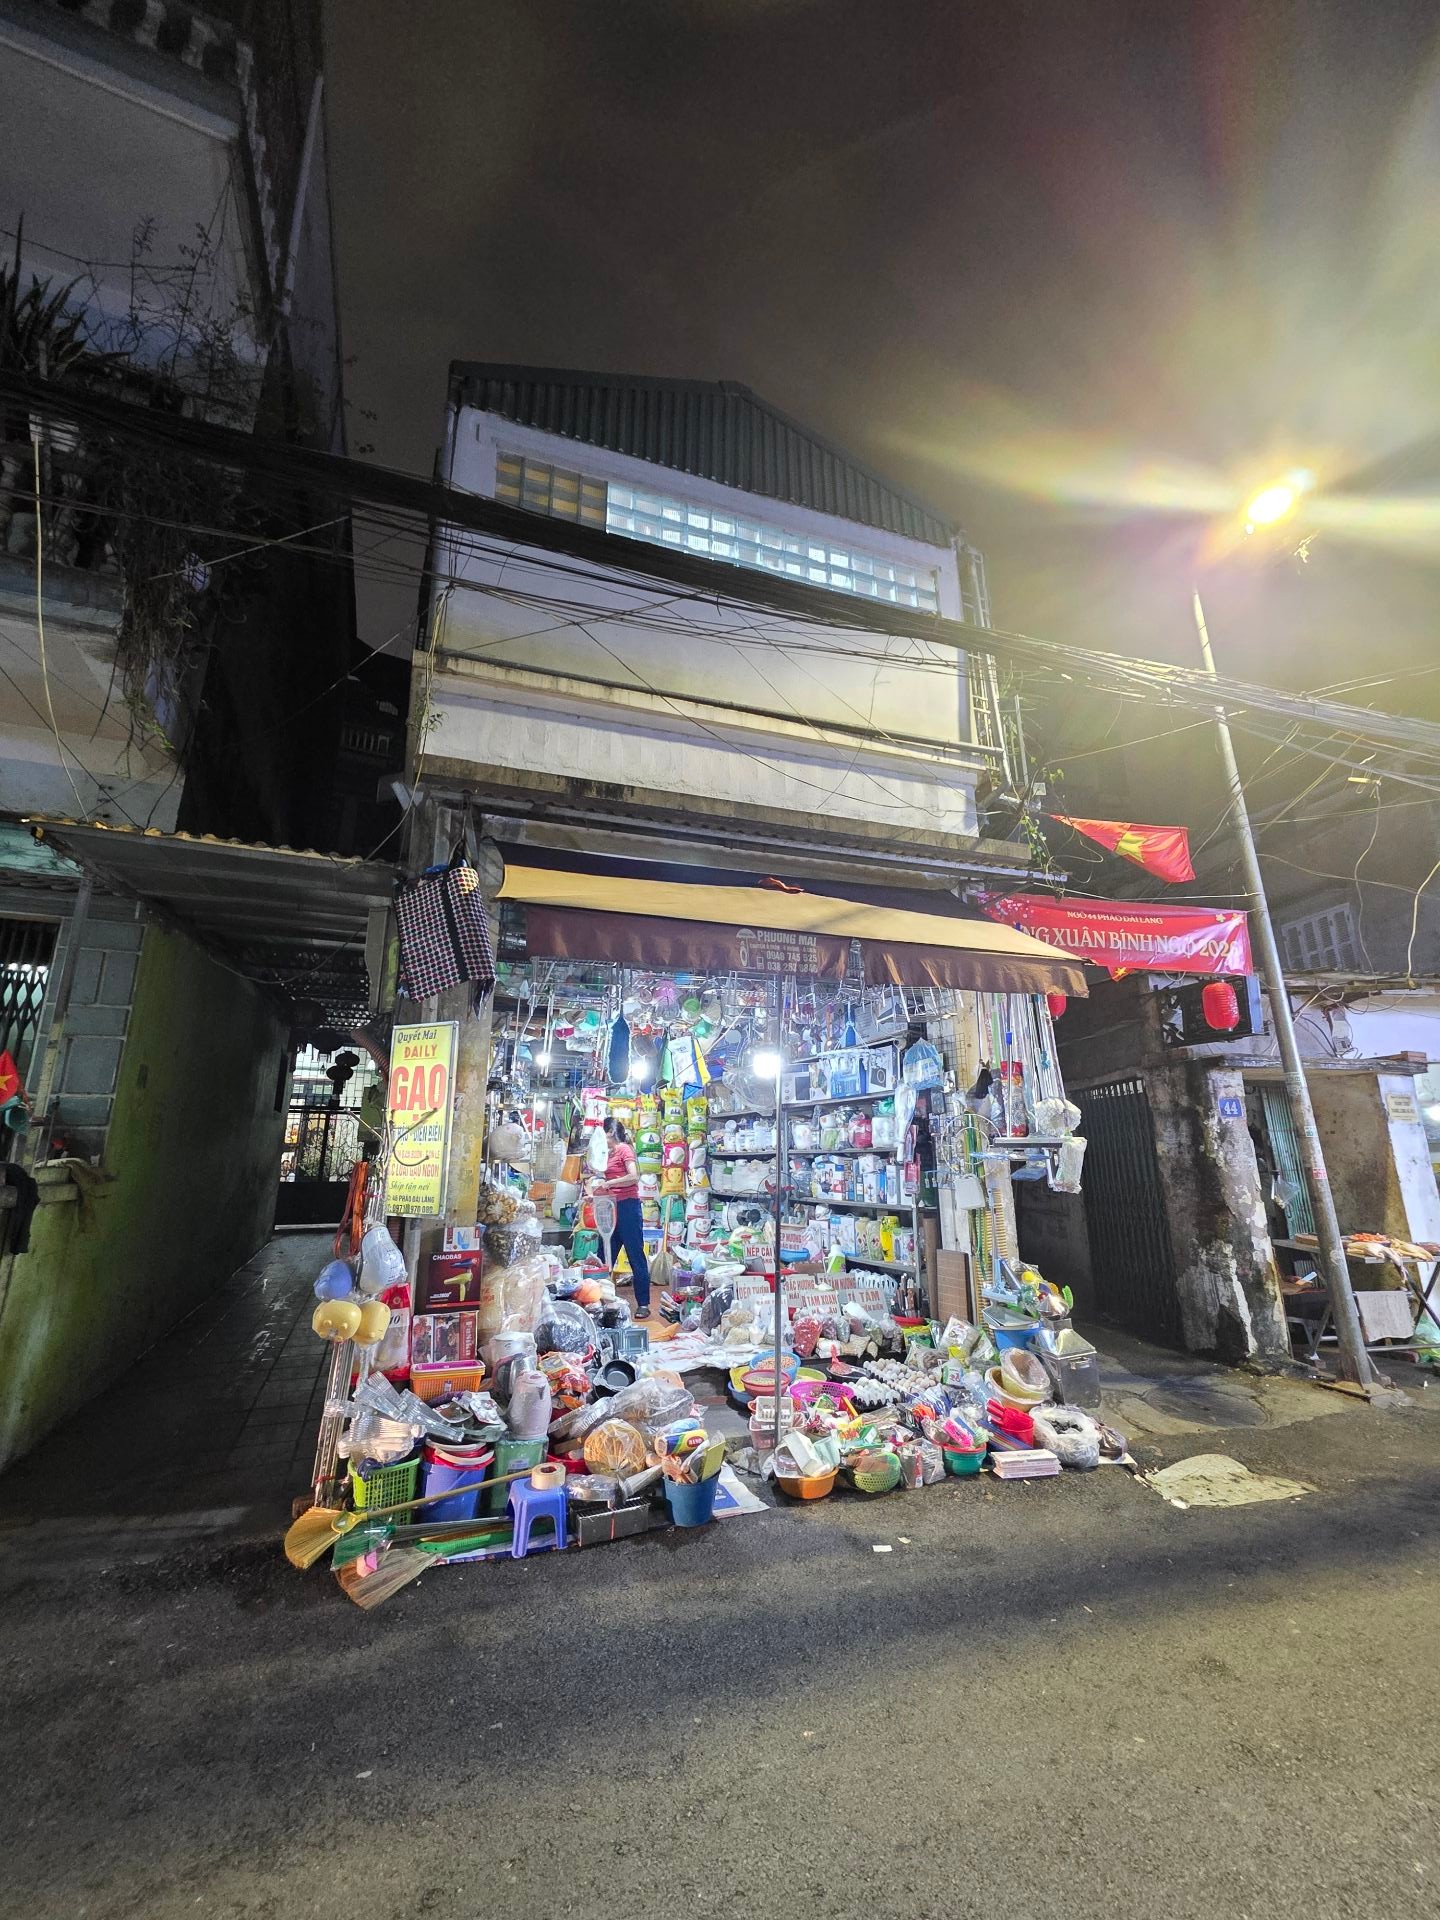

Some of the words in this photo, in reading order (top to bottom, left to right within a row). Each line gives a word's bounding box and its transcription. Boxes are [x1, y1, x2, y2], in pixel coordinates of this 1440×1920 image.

[798, 935, 817, 947] MAI
[1053, 926, 1106, 949] XUÂN
[1108, 929, 1154, 952] BÍNH
[422, 1030, 437, 1040] Mai
[390, 1064, 447, 1121] GẠO
[1224, 1101, 1239, 1115] 44
